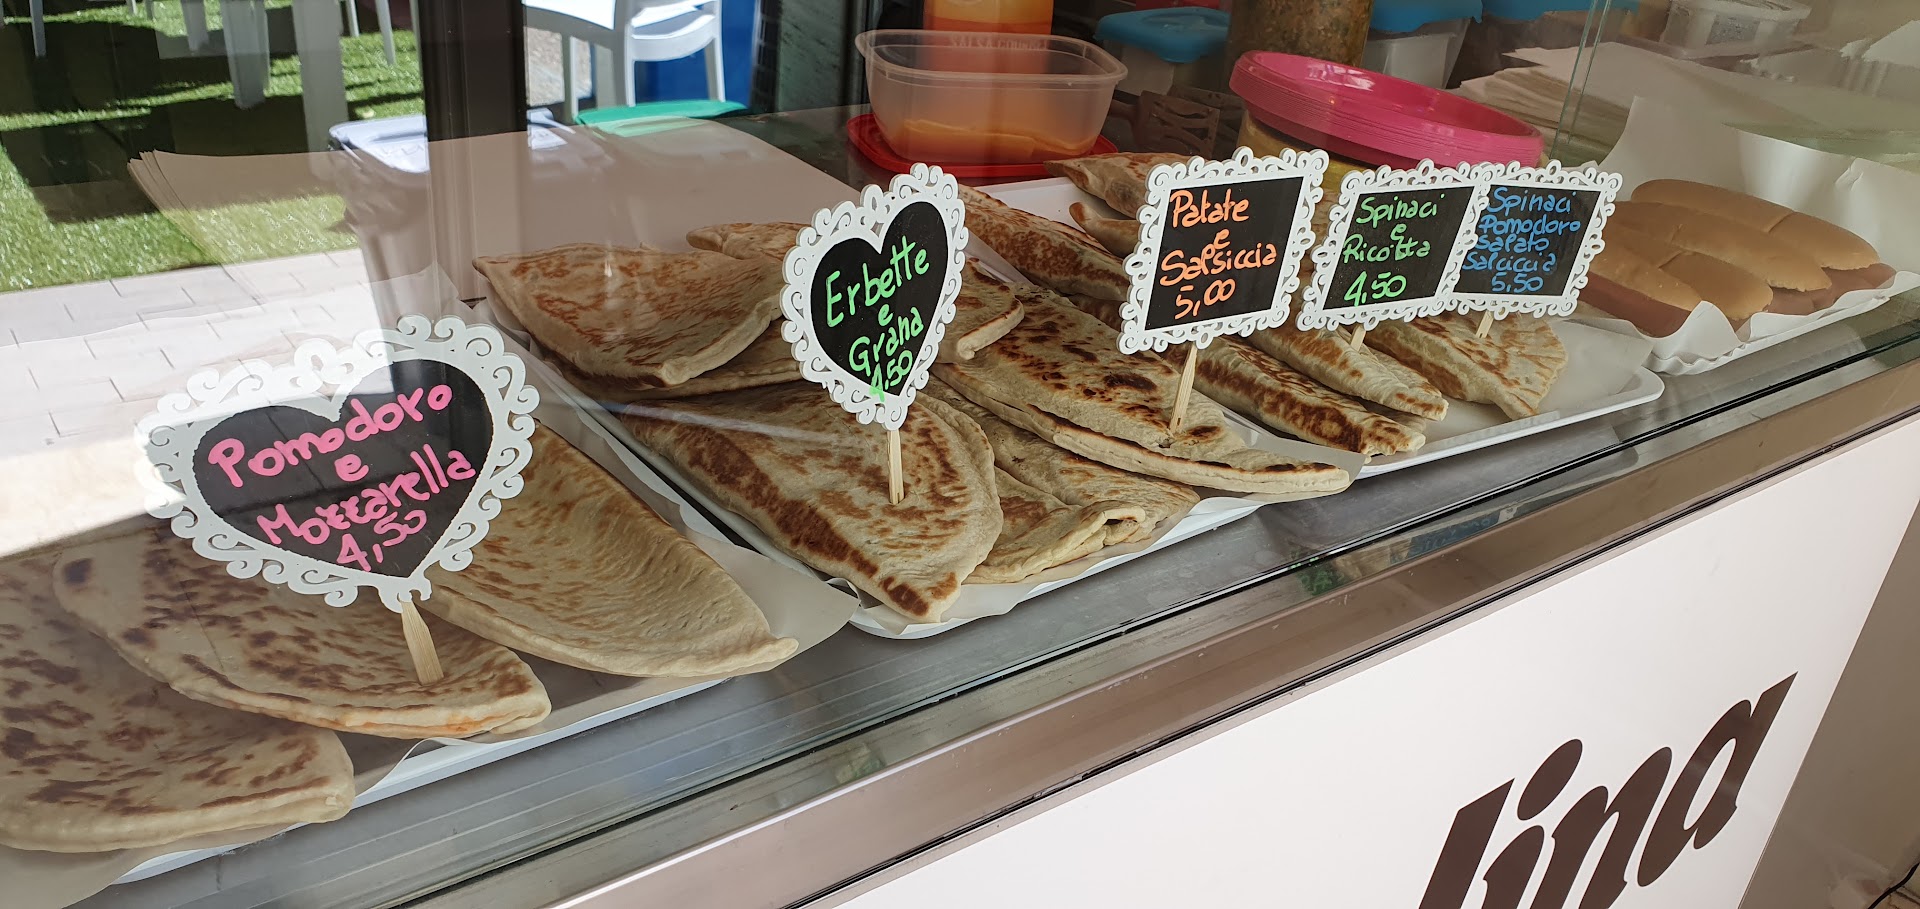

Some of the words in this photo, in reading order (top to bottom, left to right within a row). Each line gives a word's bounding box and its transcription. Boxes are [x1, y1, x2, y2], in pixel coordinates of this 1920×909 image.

[1170, 188, 1249, 228] Patate
[1356, 193, 1445, 228] Spinaci
[1486, 187, 1576, 216] Spinaci
[1214, 229, 1230, 249] e
[1390, 223, 1407, 241] e
[1478, 214, 1580, 235] Pomodoro
[1160, 243, 1277, 286] Salsiccia
[1343, 234, 1431, 263] Ricotta
[826, 235, 929, 327] Erbette
[878, 304, 894, 326] e
[849, 306, 924, 377] Grana
[208, 384, 452, 488] Pomodoro
[334, 454, 369, 482] e
[256, 444, 476, 545] Mozzarella
